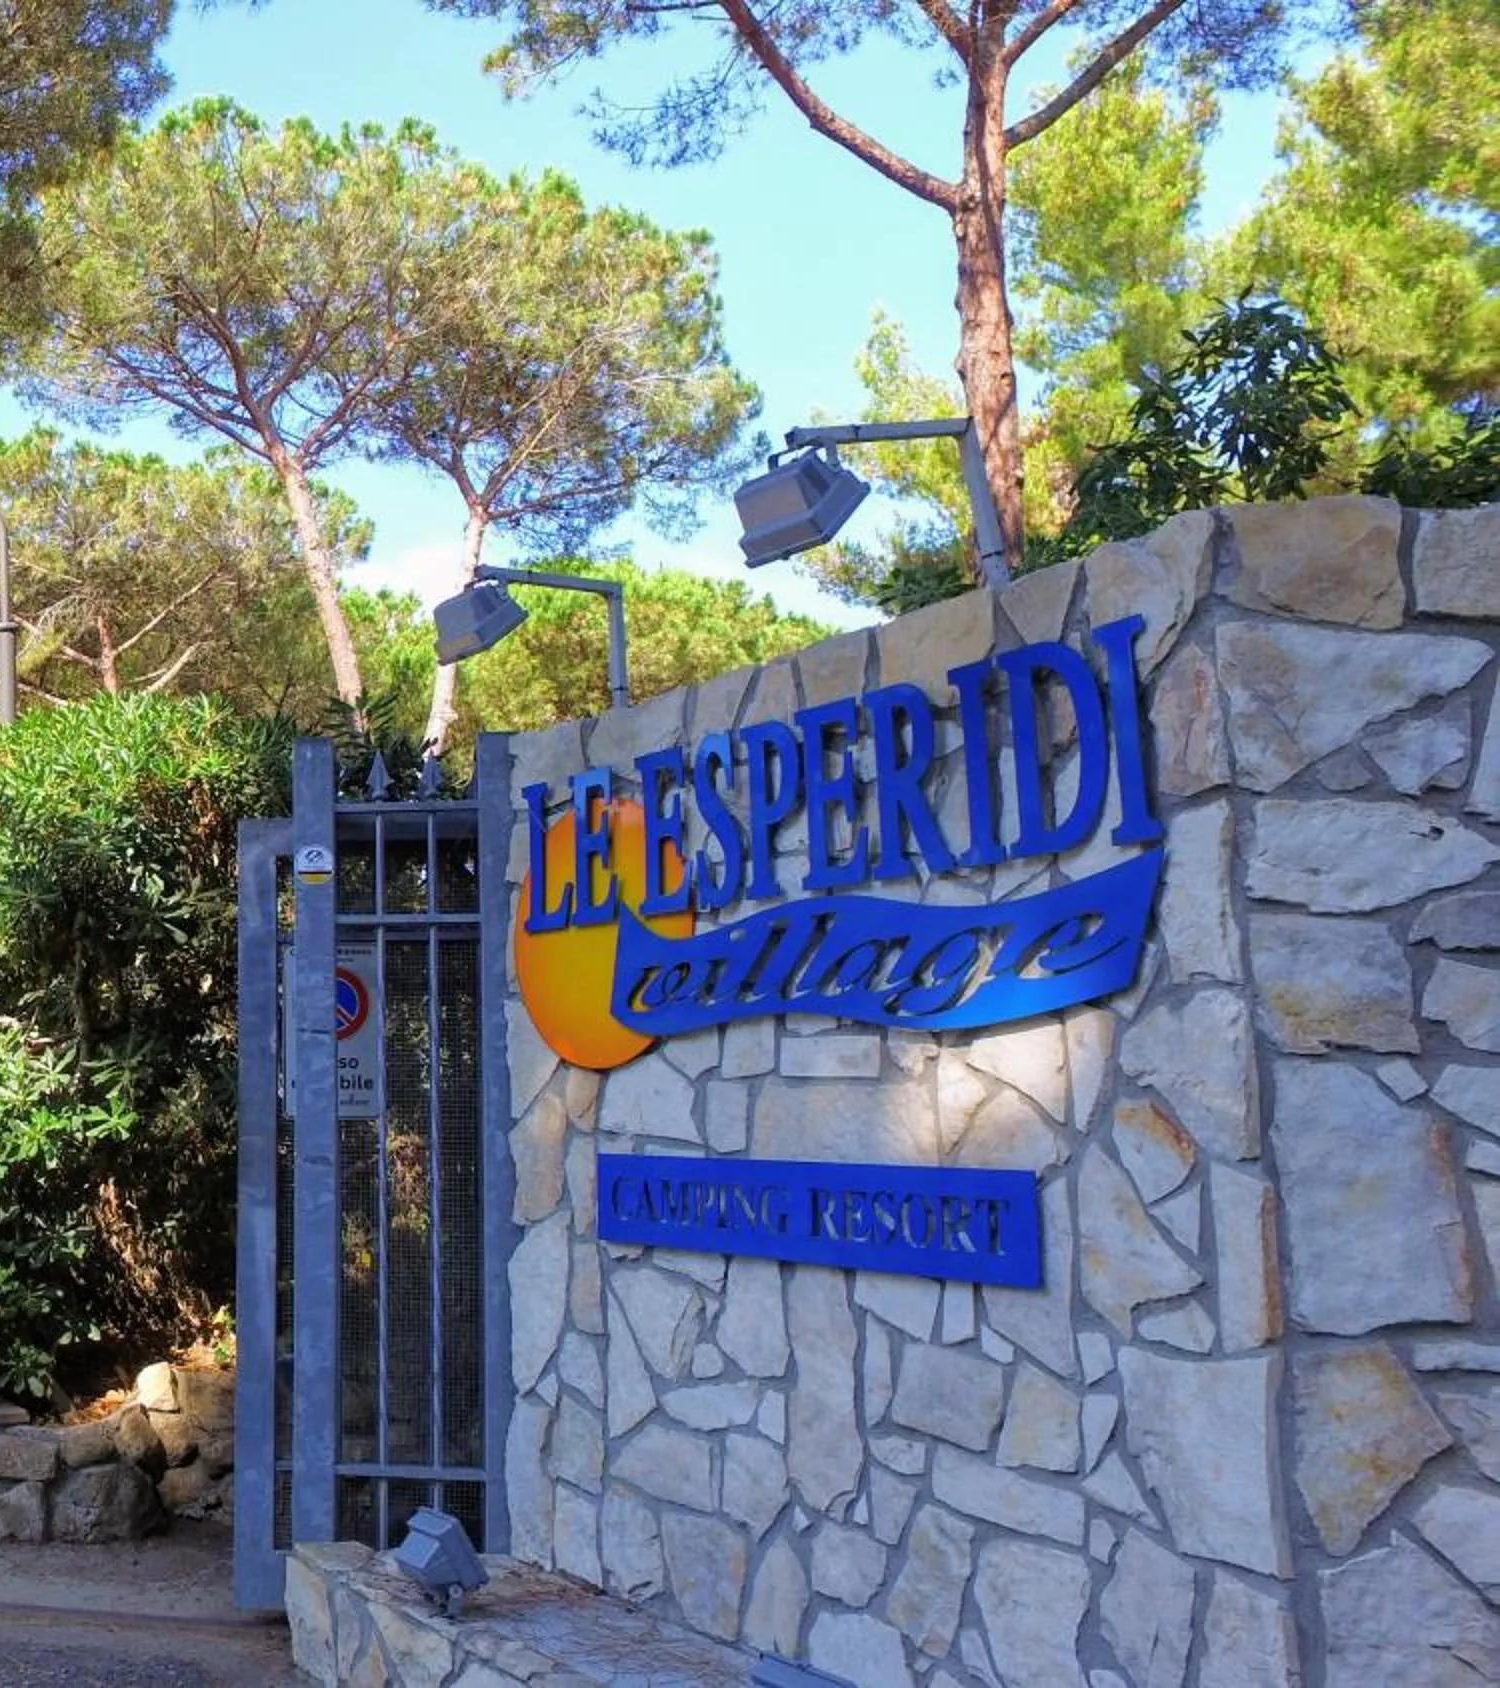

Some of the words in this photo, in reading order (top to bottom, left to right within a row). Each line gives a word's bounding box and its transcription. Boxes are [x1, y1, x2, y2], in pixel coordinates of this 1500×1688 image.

[522, 765, 618, 933] LE
[634, 613, 1165, 919] ESPERIDI
[627, 910, 1130, 1019] village
[611, 1174, 790, 1236] CAMPING
[806, 1186, 1011, 1257] RESORT
